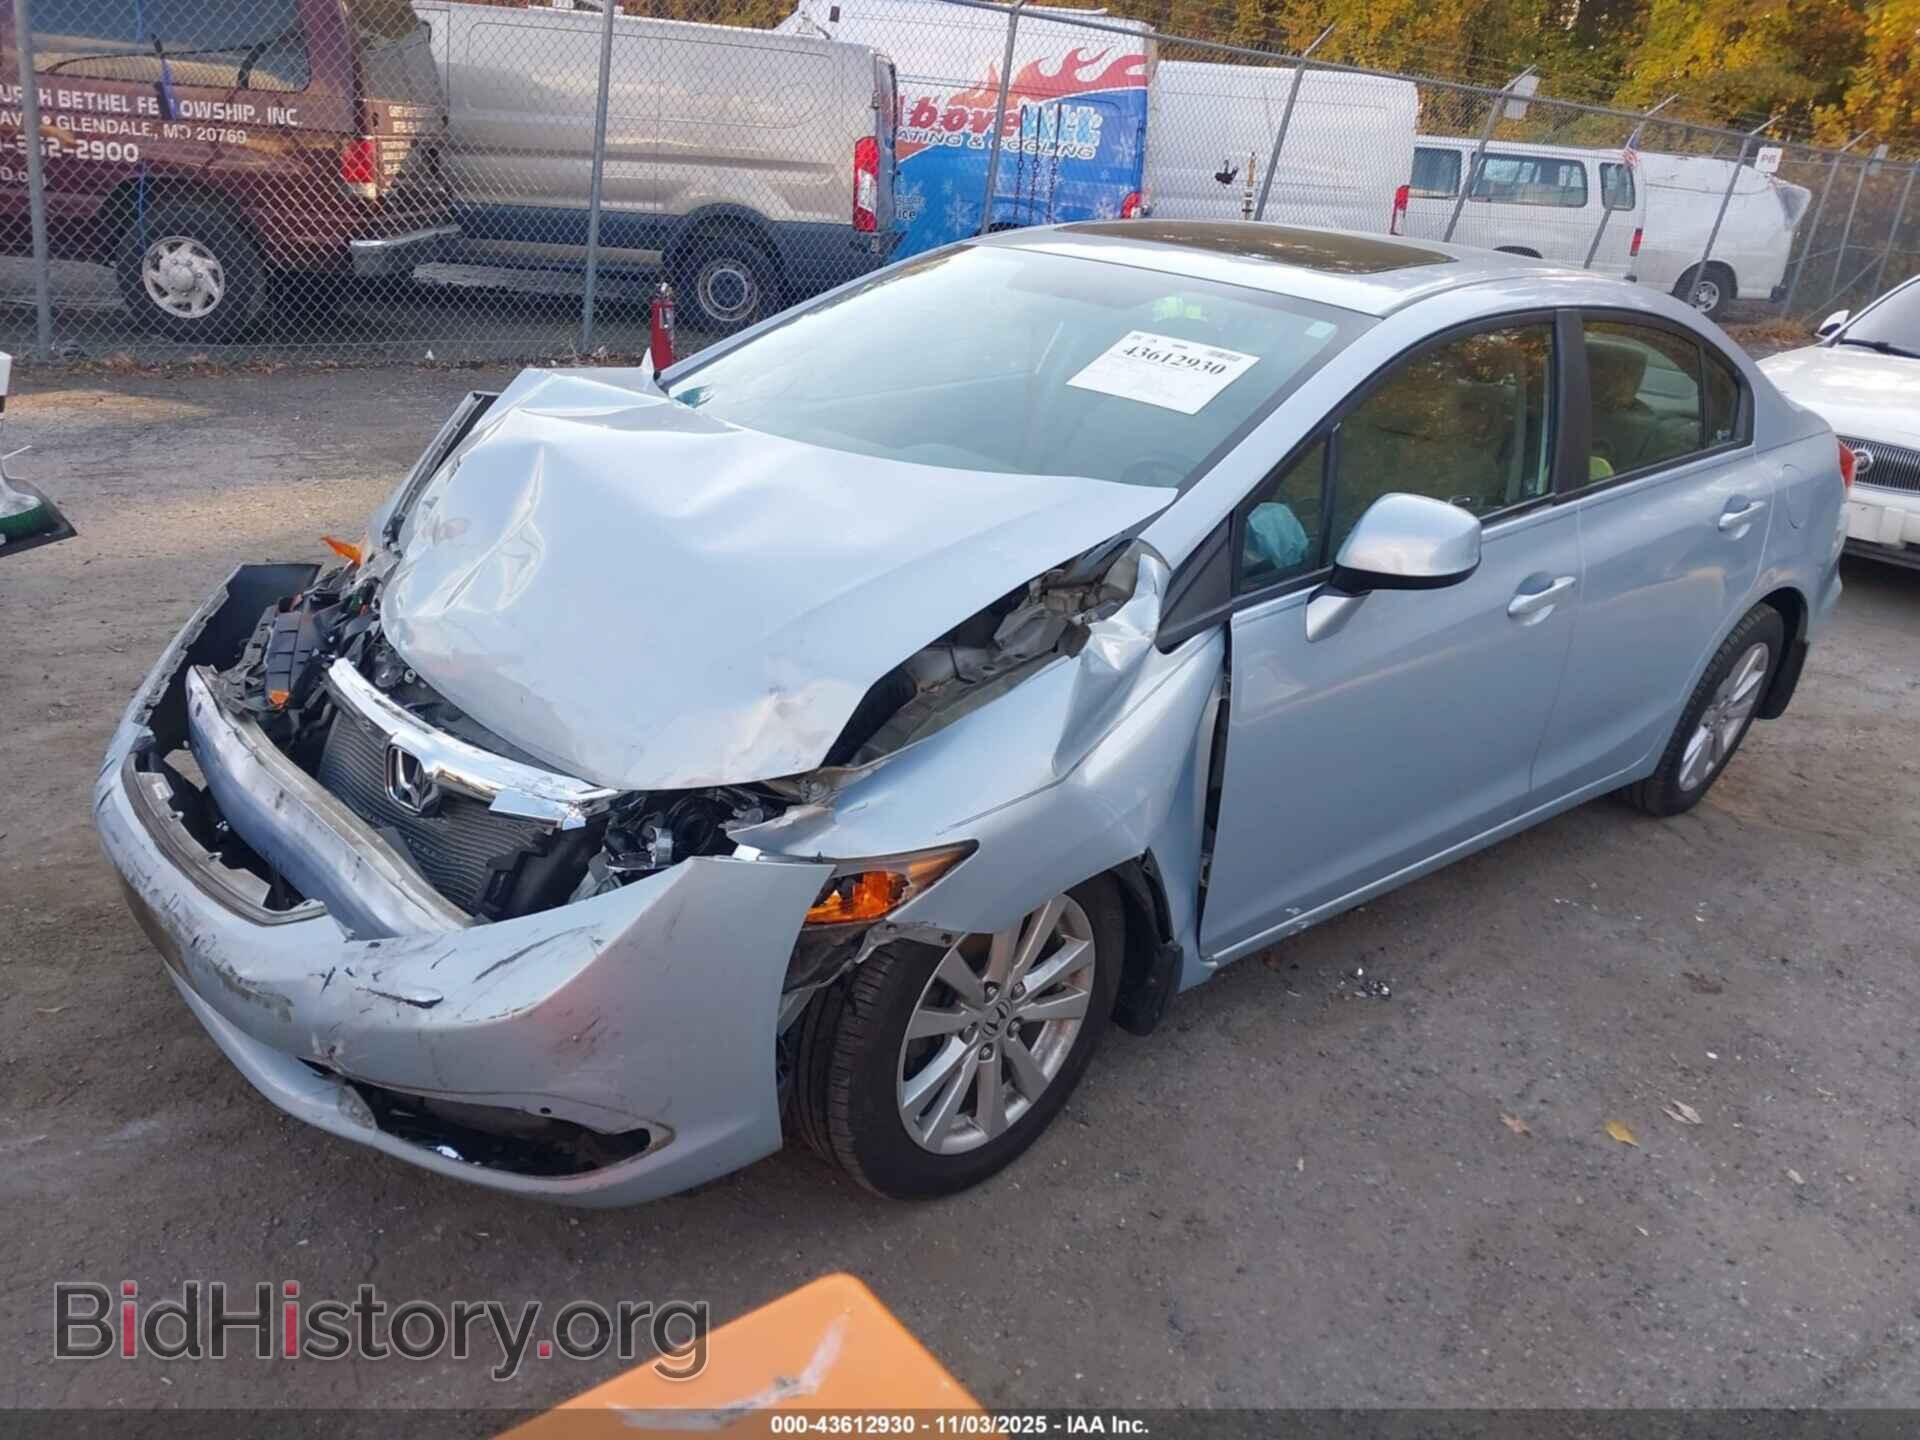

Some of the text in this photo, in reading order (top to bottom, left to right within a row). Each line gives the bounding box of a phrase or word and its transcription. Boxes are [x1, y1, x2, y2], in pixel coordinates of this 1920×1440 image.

[57, 89, 131, 112] BETHEL
[137, 96, 261, 122] FEOWSHIP,
[267, 106, 304, 126] INC.
[56, 115, 158, 140] GLENDALE,
[196, 127, 247, 144] 20769
[1123, 345, 1227, 376] 43612930
